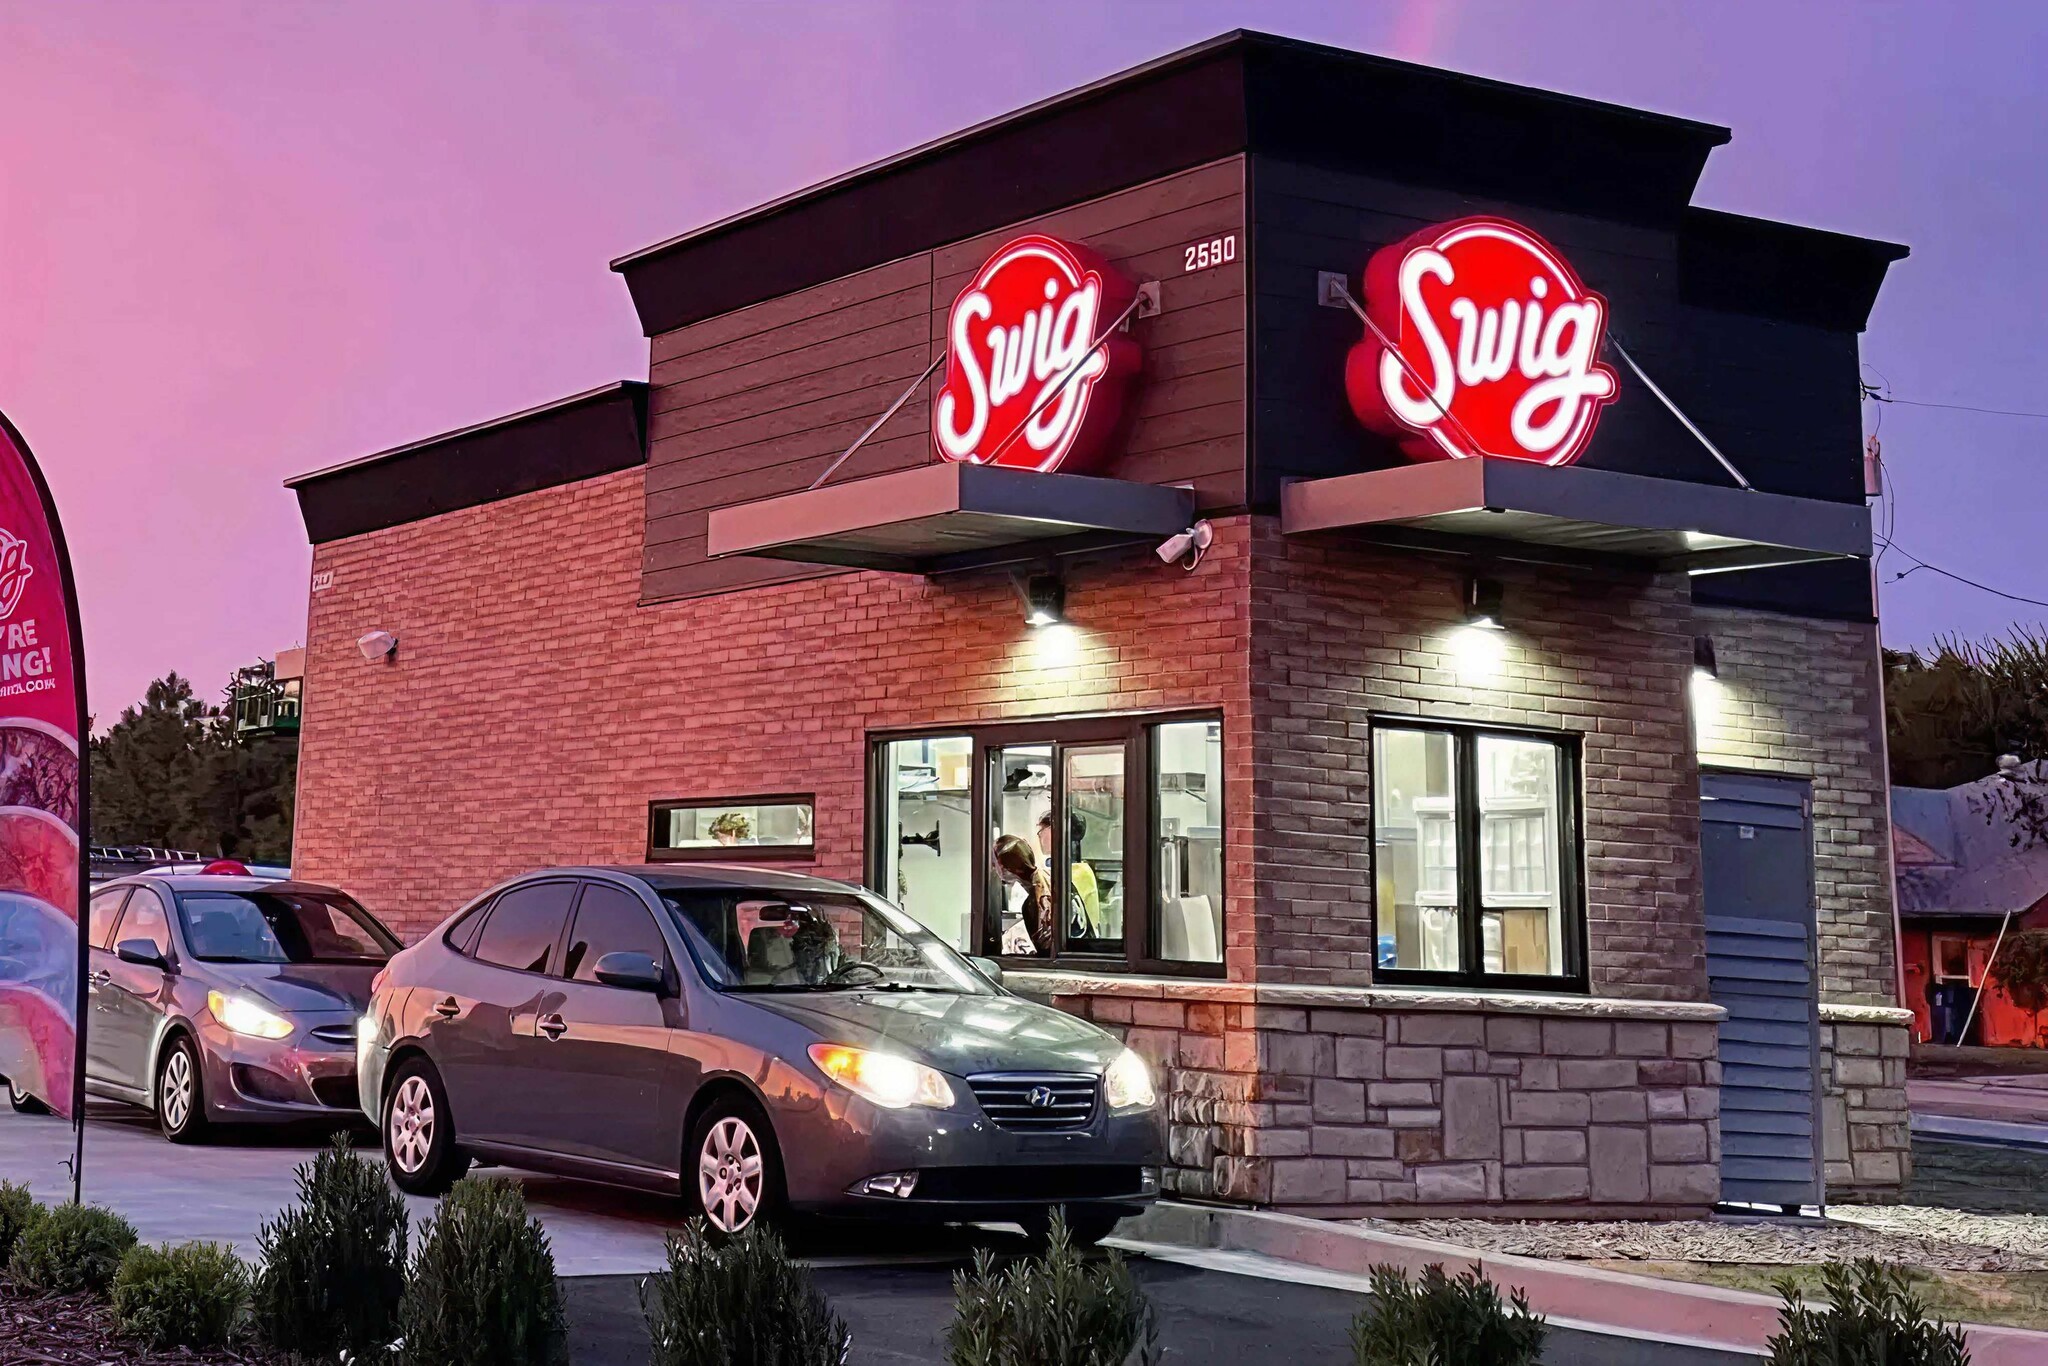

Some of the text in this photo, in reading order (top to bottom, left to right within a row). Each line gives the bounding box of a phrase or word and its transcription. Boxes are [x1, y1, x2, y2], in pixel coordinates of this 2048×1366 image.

[1185, 235, 1235, 271] 2590
[938, 276, 1106, 457] Swig
[1380, 249, 1613, 452] Swig
[0, 646, 52, 681] NG!
